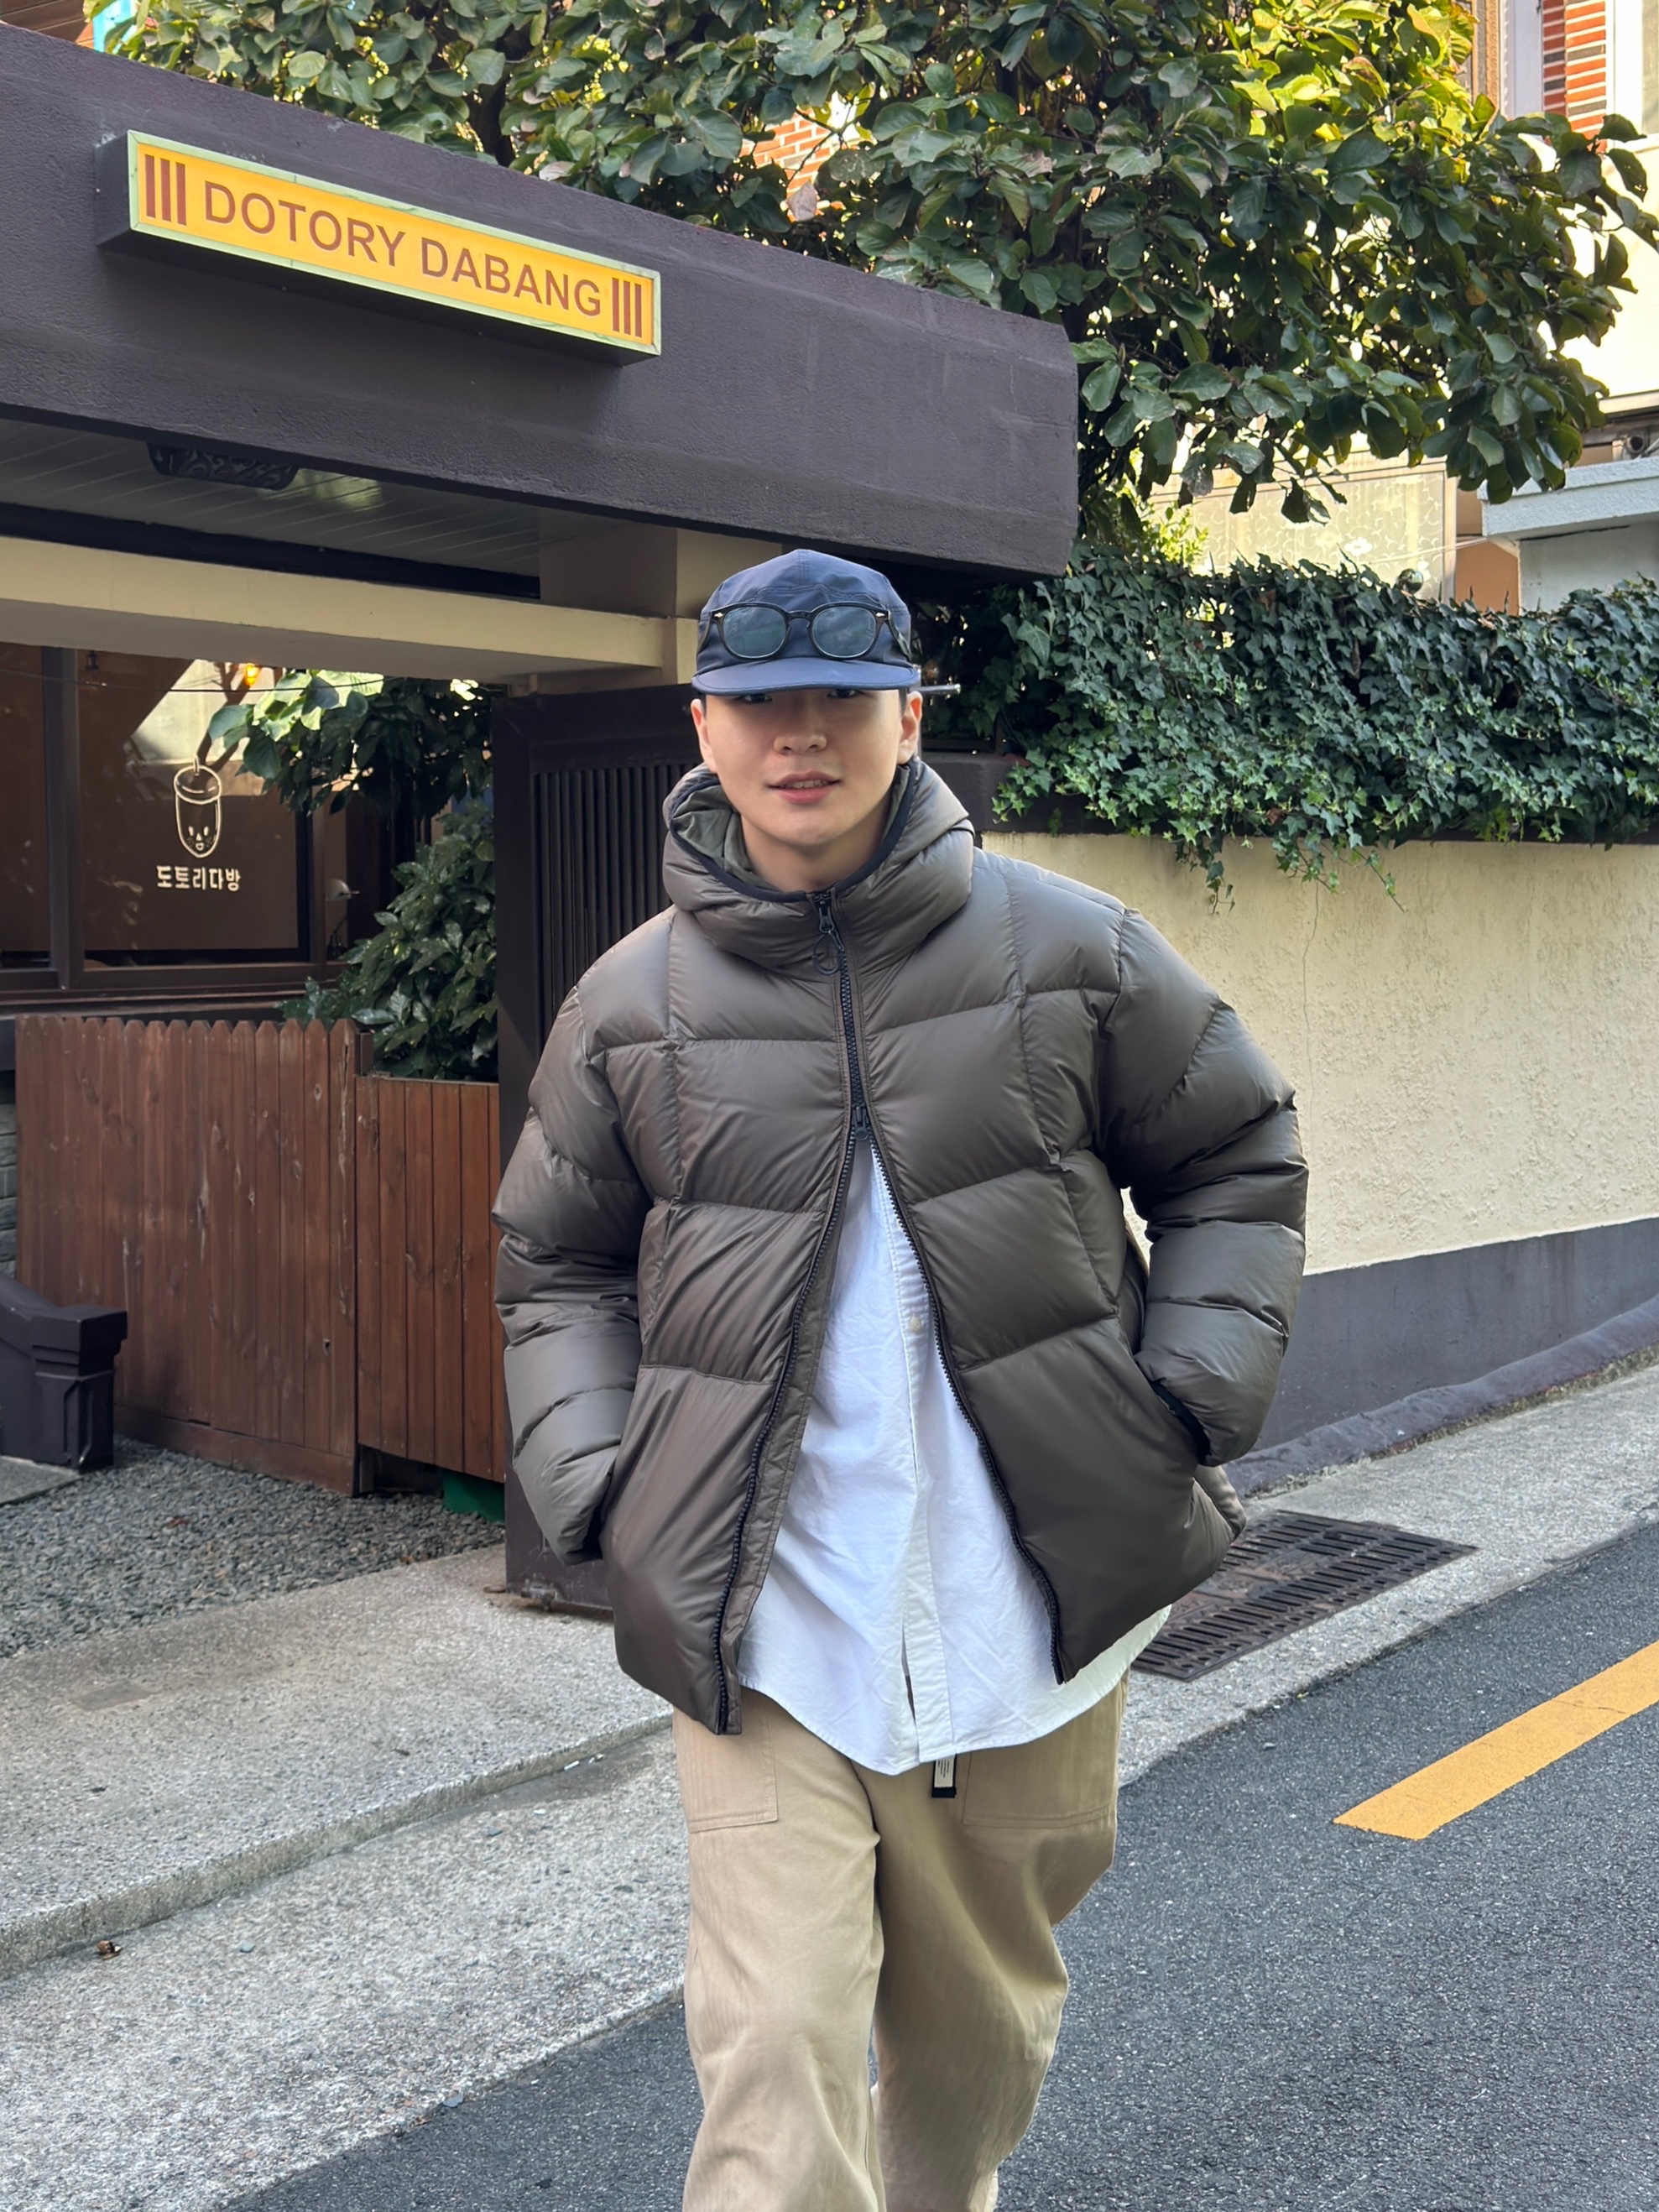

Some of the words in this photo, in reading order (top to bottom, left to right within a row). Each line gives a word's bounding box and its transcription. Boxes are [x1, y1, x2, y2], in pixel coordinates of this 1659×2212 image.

[205, 180, 405, 267] DOTORY
[421, 237, 602, 317] DABANG
[156, 865, 241, 891] 도토리다방
